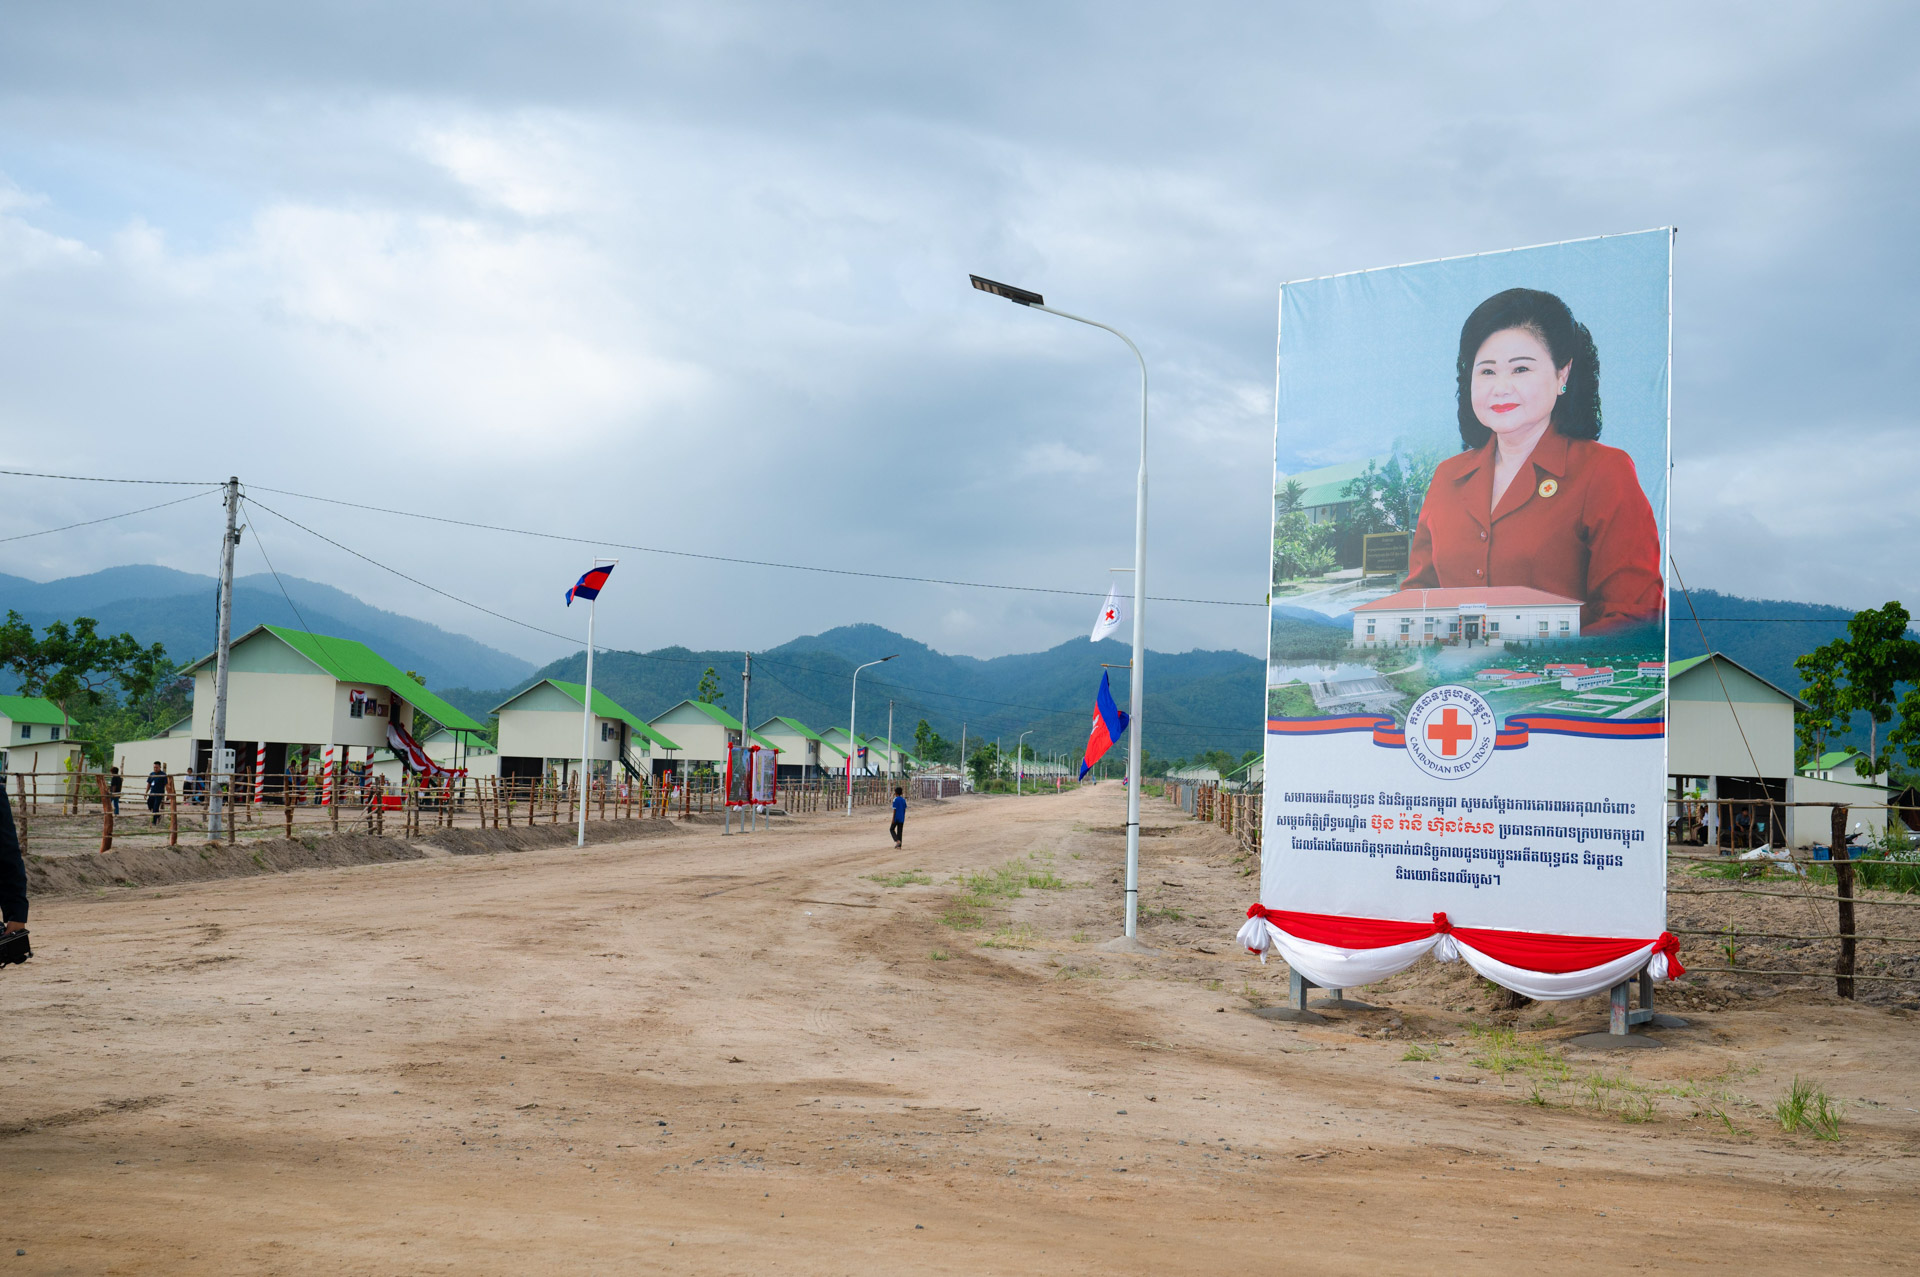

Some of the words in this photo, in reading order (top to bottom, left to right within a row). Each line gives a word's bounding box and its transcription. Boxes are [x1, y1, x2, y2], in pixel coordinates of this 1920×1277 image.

[1410, 736, 1452, 773] CAMBODIAN
[1453, 761, 1471, 773] RED
[1471, 736, 1491, 764] CROSS
